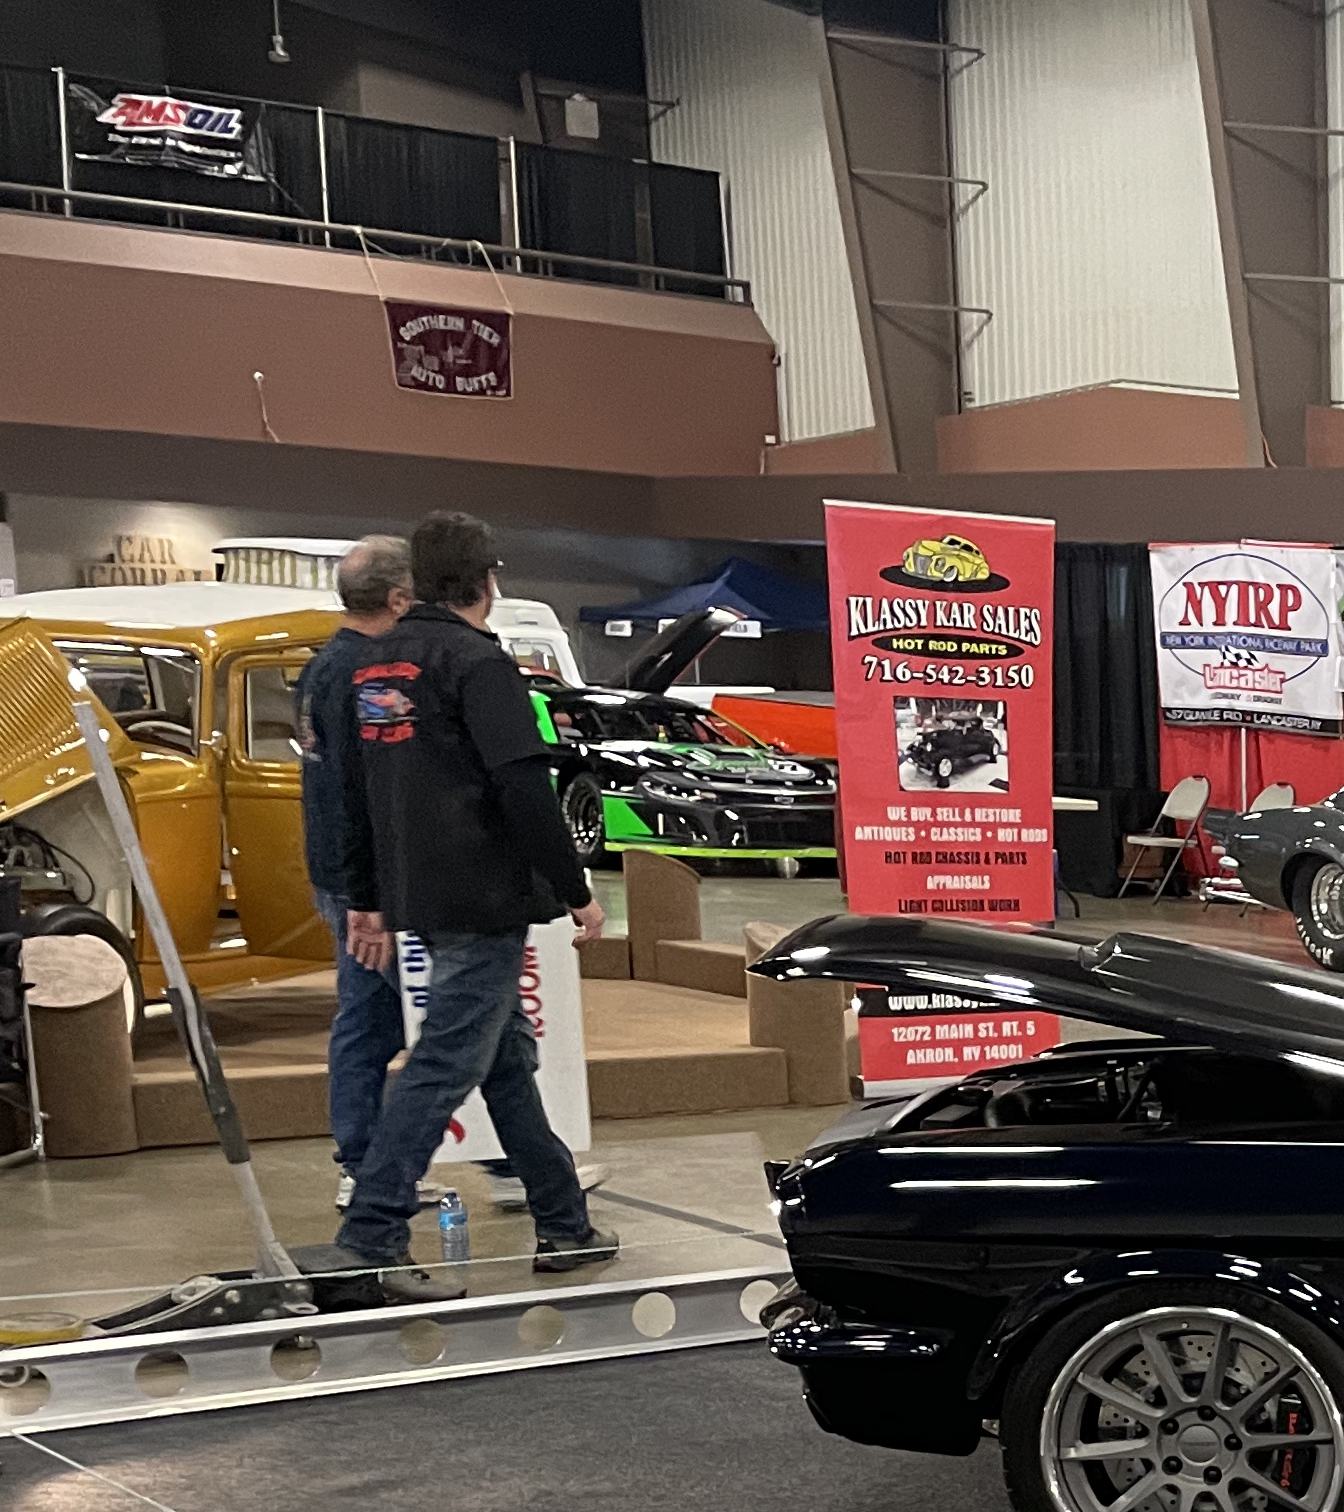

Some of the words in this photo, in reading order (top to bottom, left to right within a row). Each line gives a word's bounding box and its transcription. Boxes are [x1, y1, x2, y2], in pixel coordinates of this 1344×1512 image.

[112, 97, 239, 134] AMSOIL
[399, 314, 465, 341] SOUTHERN
[471, 319, 501, 347] TIER
[117, 533, 177, 564] CAR
[1178, 580, 1304, 632] NYIRP
[848, 596, 930, 637] KLASSY
[935, 600, 978, 629] KAR
[983, 604, 1042, 646] SALES
[892, 638, 925, 650] HOT
[928, 639, 958, 652] ROD
[961, 641, 1008, 655] PARTS
[1185, 635, 1206, 647] YORK
[1300, 641, 1324, 654] PARK
[862, 655, 1035, 688] 716-542-3150
[1205, 665, 1285, 692] Lancaster
[887, 806, 907, 821] WE
[936, 808, 962, 822] SELL
[974, 808, 1022, 823] RESTORE
[854, 826, 916, 842] ANTIQUES
[930, 827, 982, 842] CLASSICS
[997, 828, 1019, 842] HOT
[1020, 828, 1048, 843] RODS
[884, 851, 907, 864] HOT
[911, 851, 932, 865] ROD
[935, 851, 981, 865] CHASSIS
[994, 852, 1028, 865] PARTS
[926, 875, 991, 890] APPRAISALS
[898, 899, 928, 913] LIGHT
[931, 899, 985, 912] COLLISION
[988, 898, 1021, 912] WORK
[891, 1026, 932, 1043] 12072
[935, 1023, 974, 1040] MAIN
[977, 1022, 998, 1038] ST.
[1026, 1020, 1036, 1036] 5
[963, 1045, 982, 1062] NY
[983, 1044, 1024, 1061] 14001
